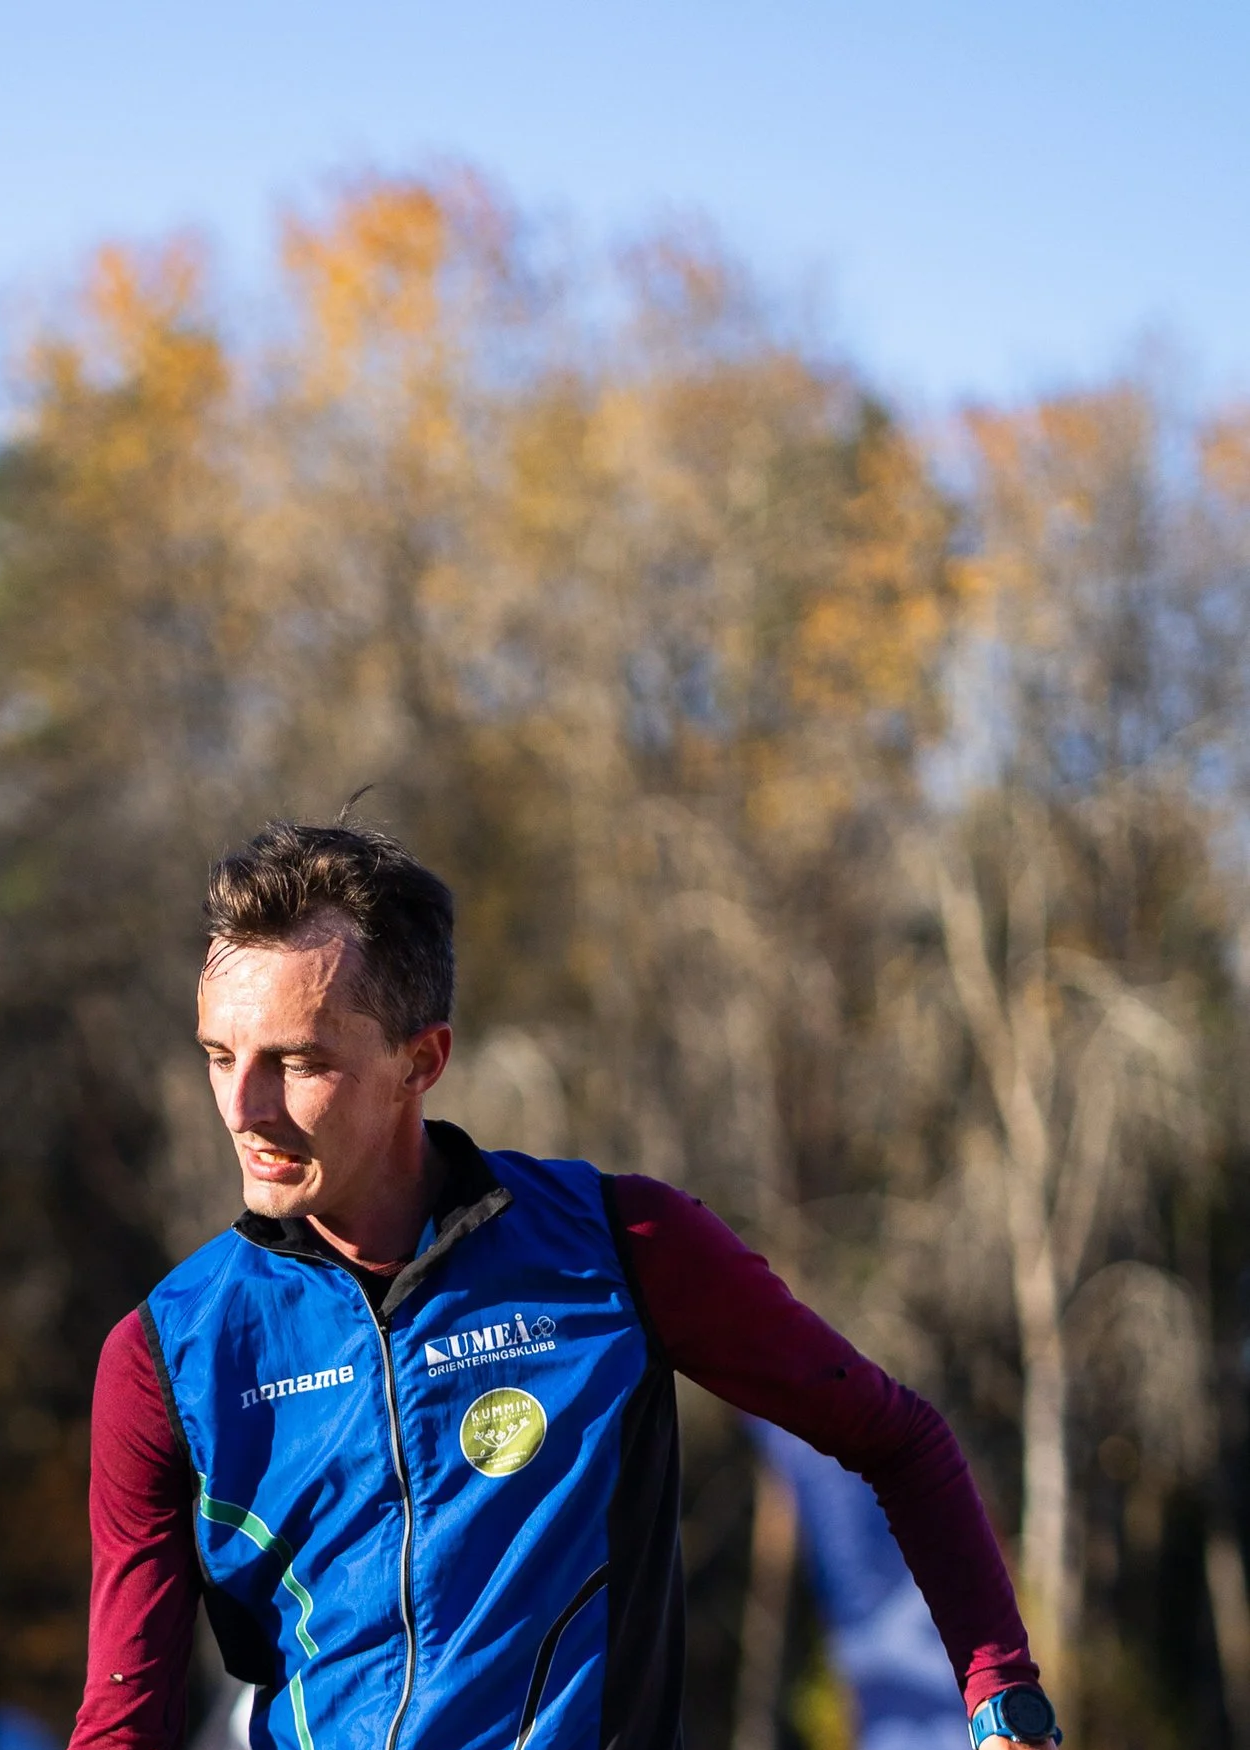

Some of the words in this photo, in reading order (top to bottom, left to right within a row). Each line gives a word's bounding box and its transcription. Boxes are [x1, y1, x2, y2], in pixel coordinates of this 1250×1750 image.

[449, 1313, 532, 1358] UMEÅ
[428, 1340, 556, 1378] ORIENTERINGSKLUBB
[240, 1365, 354, 1409] noname
[471, 1399, 532, 1422] KUMMIN
